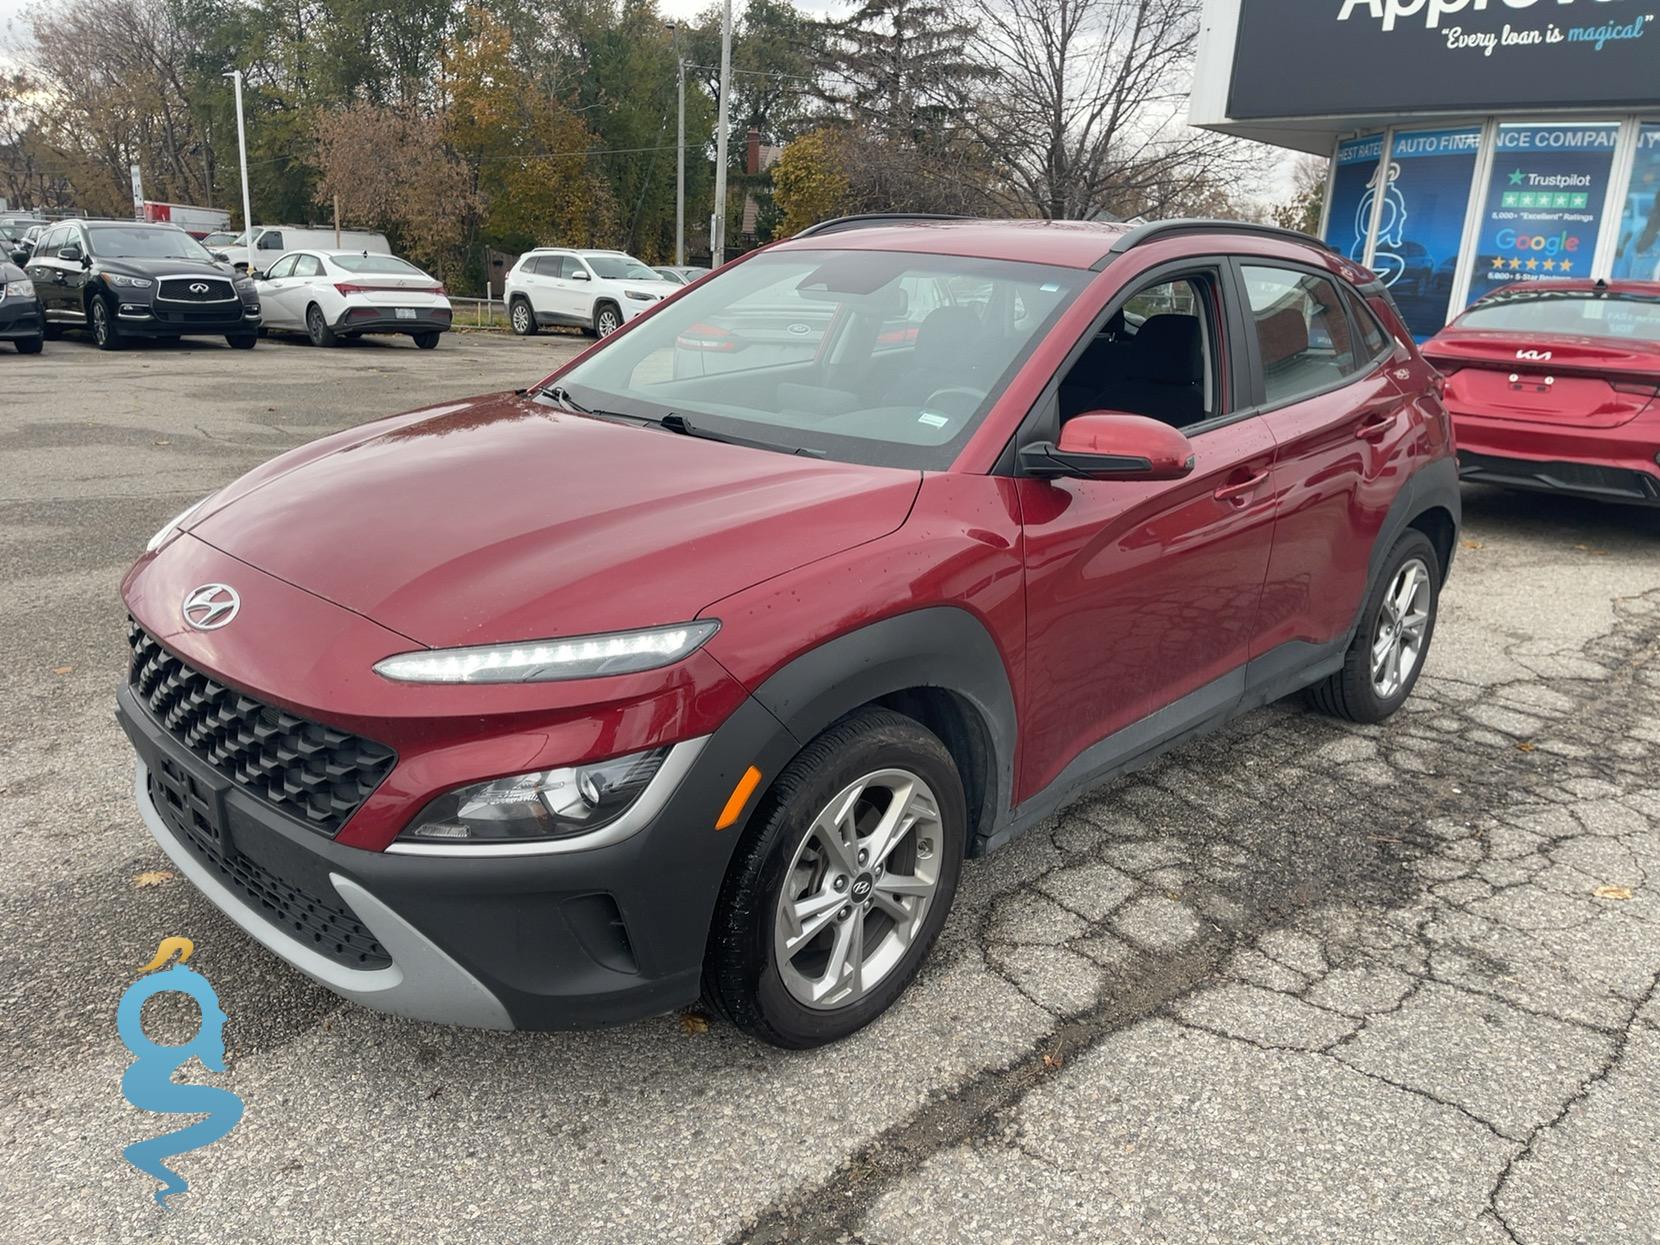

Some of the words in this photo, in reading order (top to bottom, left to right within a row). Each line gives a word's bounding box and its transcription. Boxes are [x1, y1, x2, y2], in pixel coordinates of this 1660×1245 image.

[1501, 24, 1543, 45] loan
[1546, 24, 1564, 43] is
[1397, 137, 1437, 153] AUTO
[1528, 173, 1592, 188] Trustpilot
[1563, 212, 1594, 223] Ratings
[1495, 228, 1580, 256] Google
